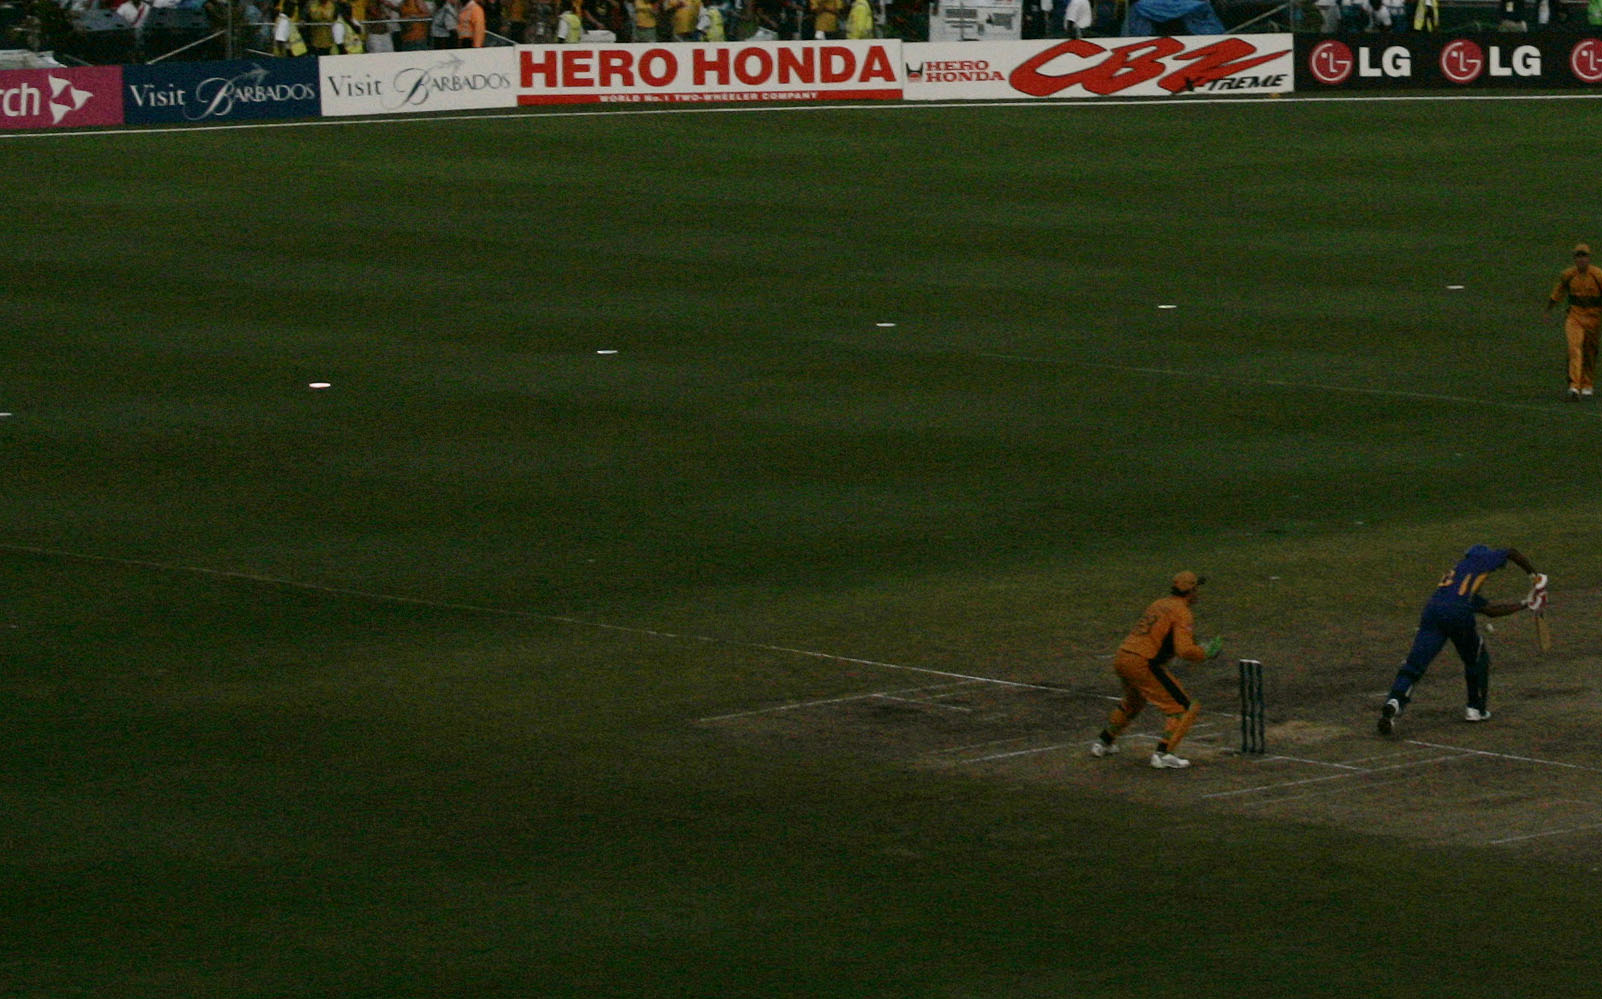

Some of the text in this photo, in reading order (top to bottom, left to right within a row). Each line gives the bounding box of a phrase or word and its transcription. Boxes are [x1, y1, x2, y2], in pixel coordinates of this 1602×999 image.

[519, 44, 896, 89] HERO HONDA
[926, 59, 989, 71] HERO
[926, 70, 1006, 83] HONDA
[1008, 36, 1293, 98] CBZ
[1358, 45, 1412, 78] LG
[1489, 44, 1542, 77] LG
[130, 68, 318, 120] Visit BARBADOS
[327, 65, 511, 110] Visit BARBADOS
[599, 94, 641, 103] WORLD
[674, 92, 758, 102] TWO-WHEELER
[762, 91, 818, 101] COMPANY
